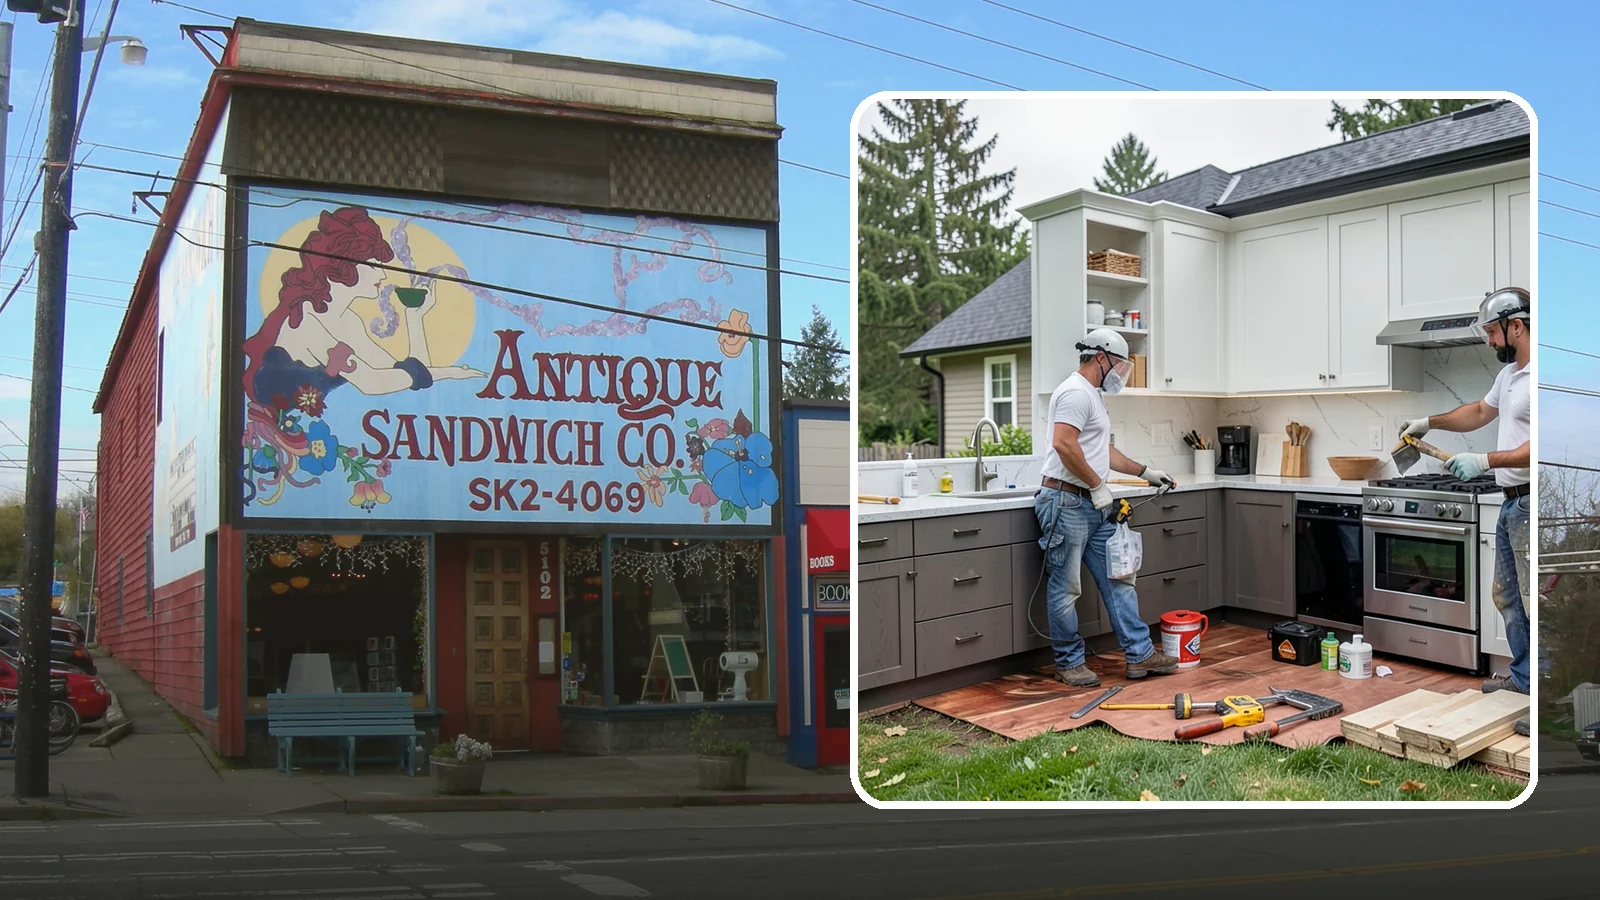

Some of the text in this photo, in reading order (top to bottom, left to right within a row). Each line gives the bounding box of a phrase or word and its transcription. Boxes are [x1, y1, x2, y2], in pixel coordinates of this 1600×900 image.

[475, 329, 723, 420] ANTIQUE
[361, 408, 685, 468] SANDWICH CO.
[468, 476, 645, 513] SK2-4069
[540, 541, 551, 599] 5102
[809, 555, 834, 568] BOOKS
